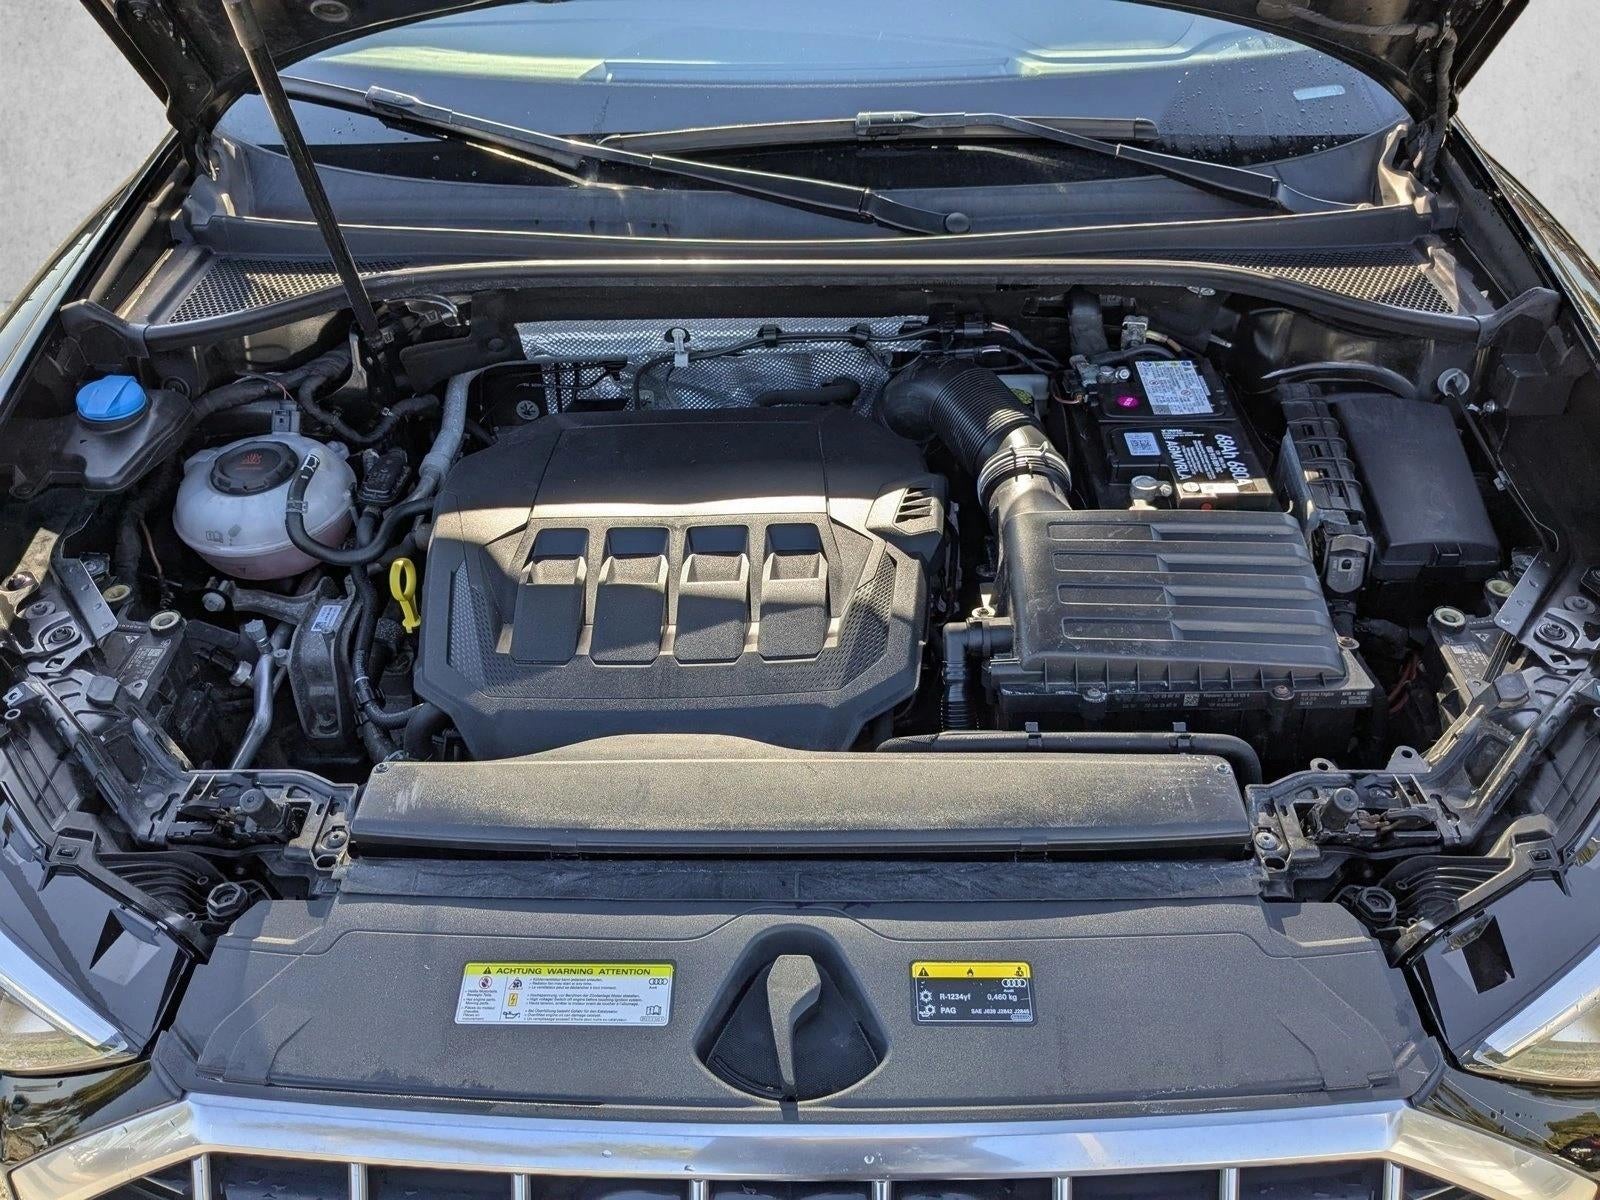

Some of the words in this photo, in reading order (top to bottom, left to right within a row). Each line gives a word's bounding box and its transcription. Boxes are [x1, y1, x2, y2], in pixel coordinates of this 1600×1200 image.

[1165, 441, 1191, 480] AGM/VRLA
[1214, 434, 1240, 459] 68Ah
[1227, 461, 1253, 486] 680A
[940, 993, 971, 1002] R-1234yf
[1008, 993, 1018, 1002] kg
